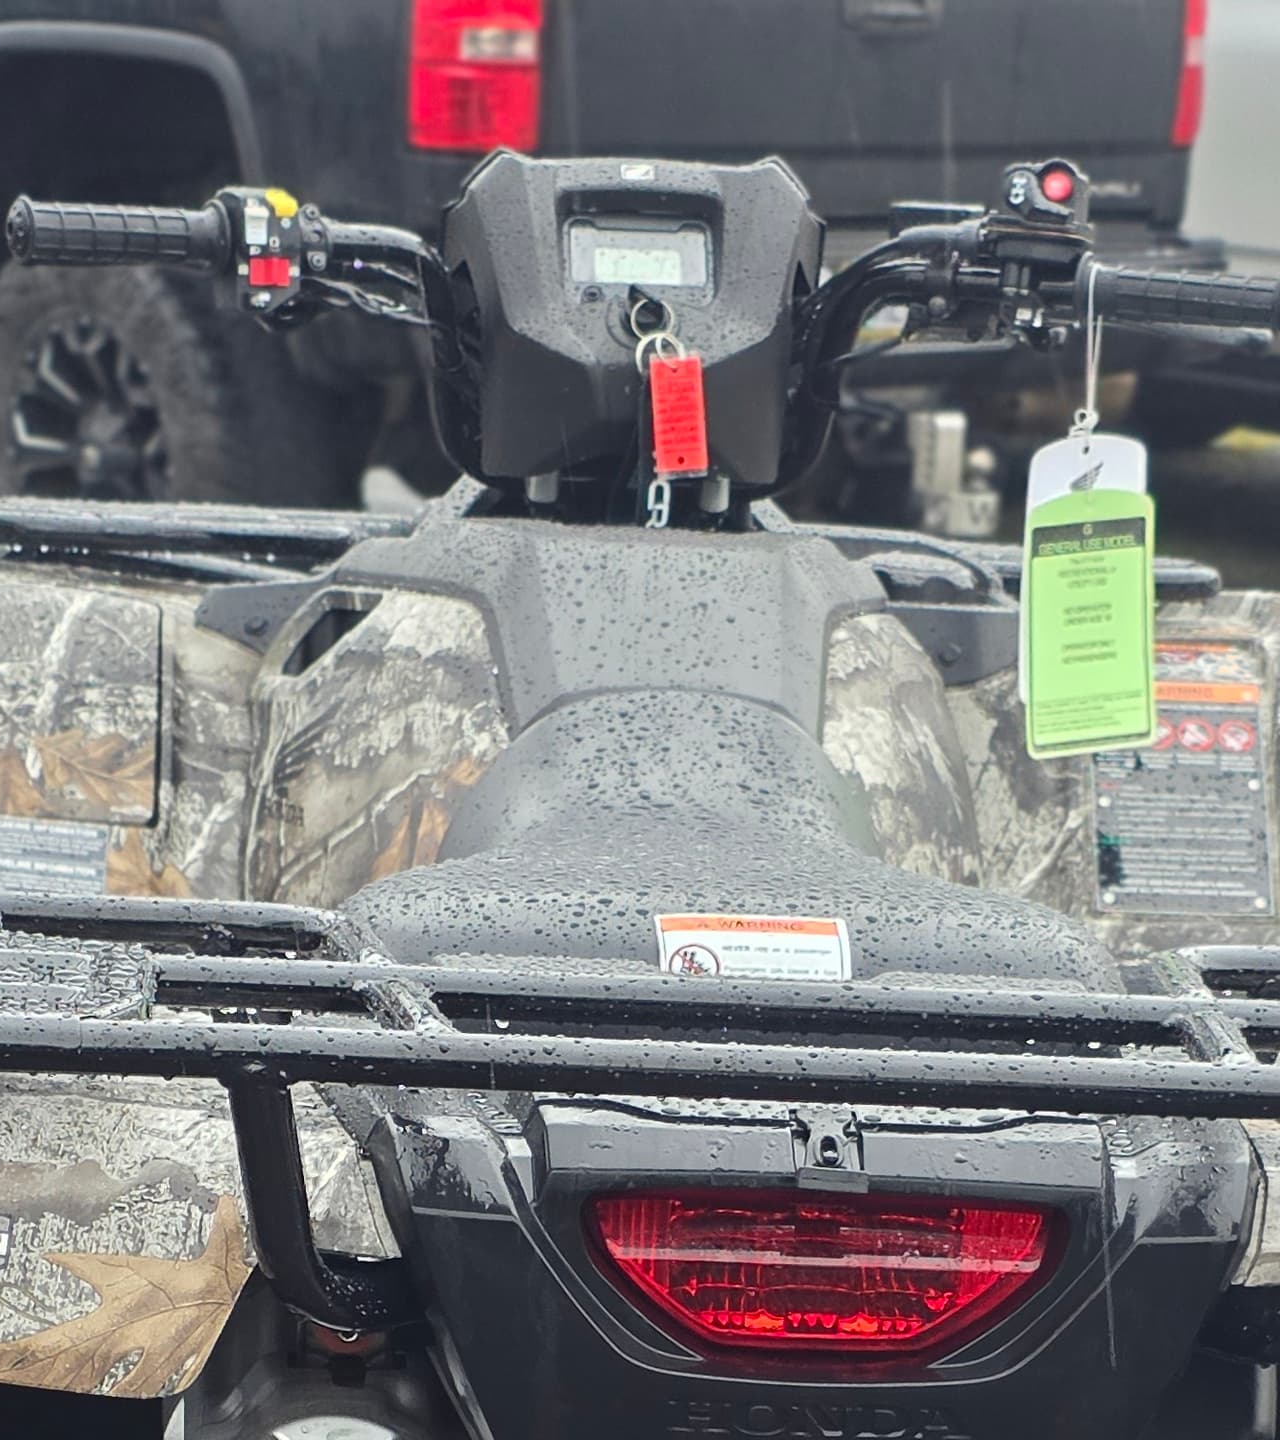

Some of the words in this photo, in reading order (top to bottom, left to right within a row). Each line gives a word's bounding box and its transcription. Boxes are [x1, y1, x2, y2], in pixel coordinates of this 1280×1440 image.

[1082, 523, 1093, 536] G
[718, 919, 804, 932] WARNING
[667, 1400, 972, 1440] HONDA
